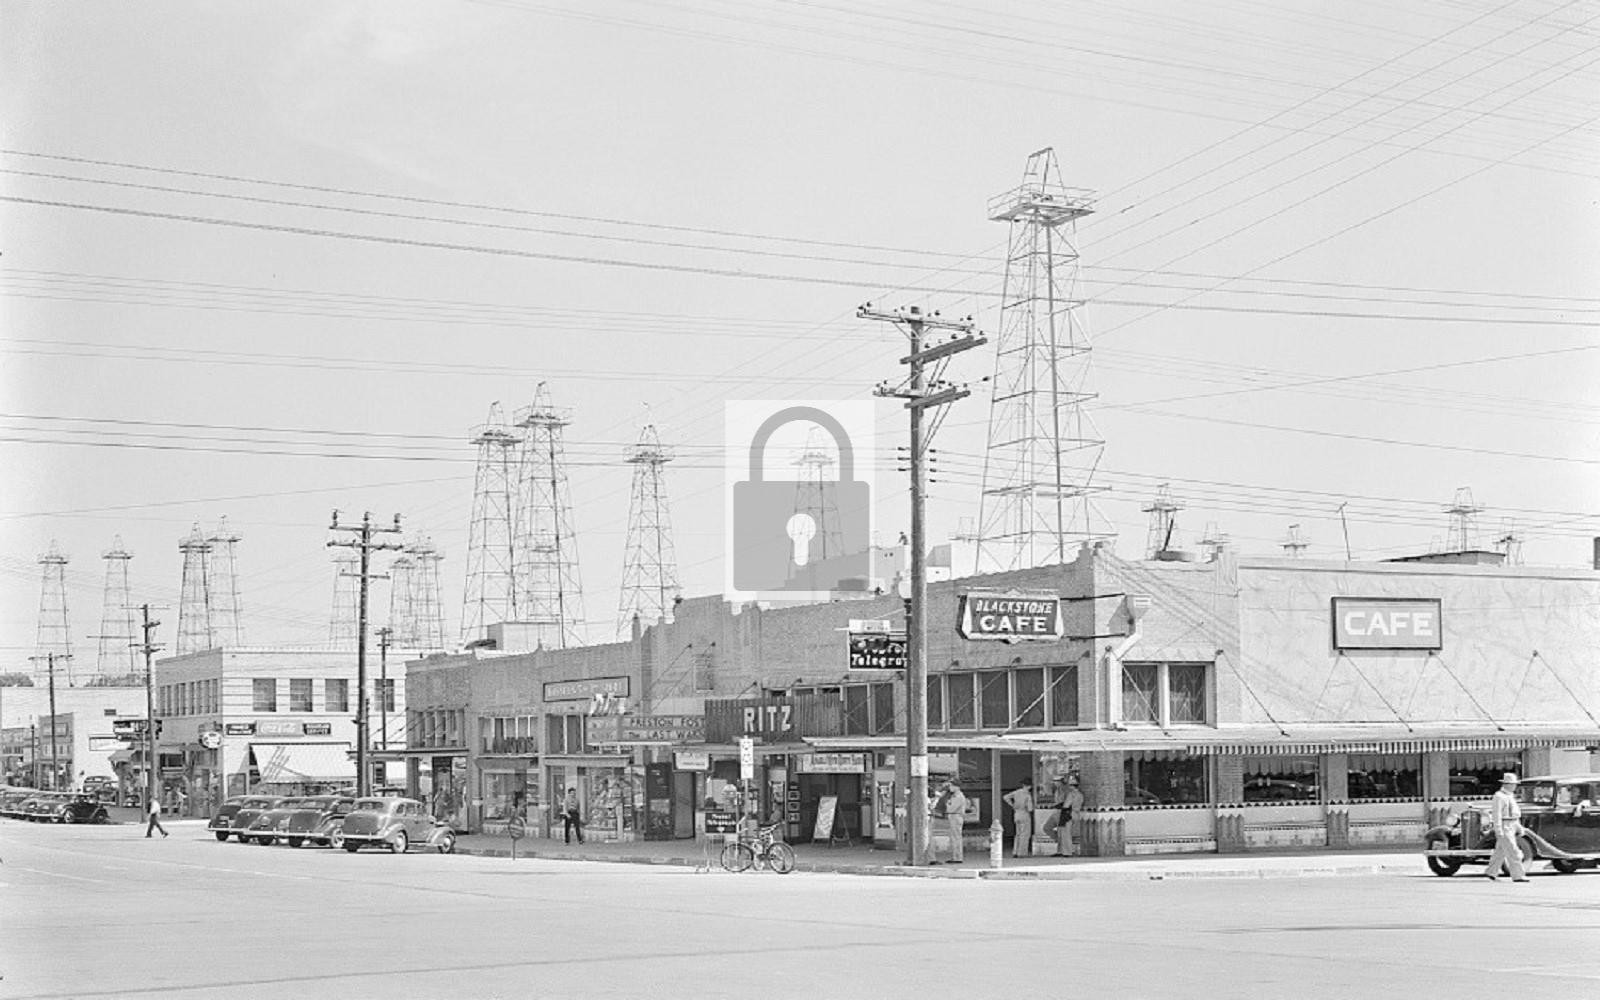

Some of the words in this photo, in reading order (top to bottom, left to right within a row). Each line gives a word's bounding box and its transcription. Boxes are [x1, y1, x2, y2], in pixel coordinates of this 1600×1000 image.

[975, 600, 1054, 614] BLACKSTONE
[979, 615, 1048, 632] CAFE
[1344, 611, 1433, 636] CAFE
[630, 717, 673, 728] PRESTON
[743, 705, 791, 732] RITZ
[648, 730, 673, 740] LAST
